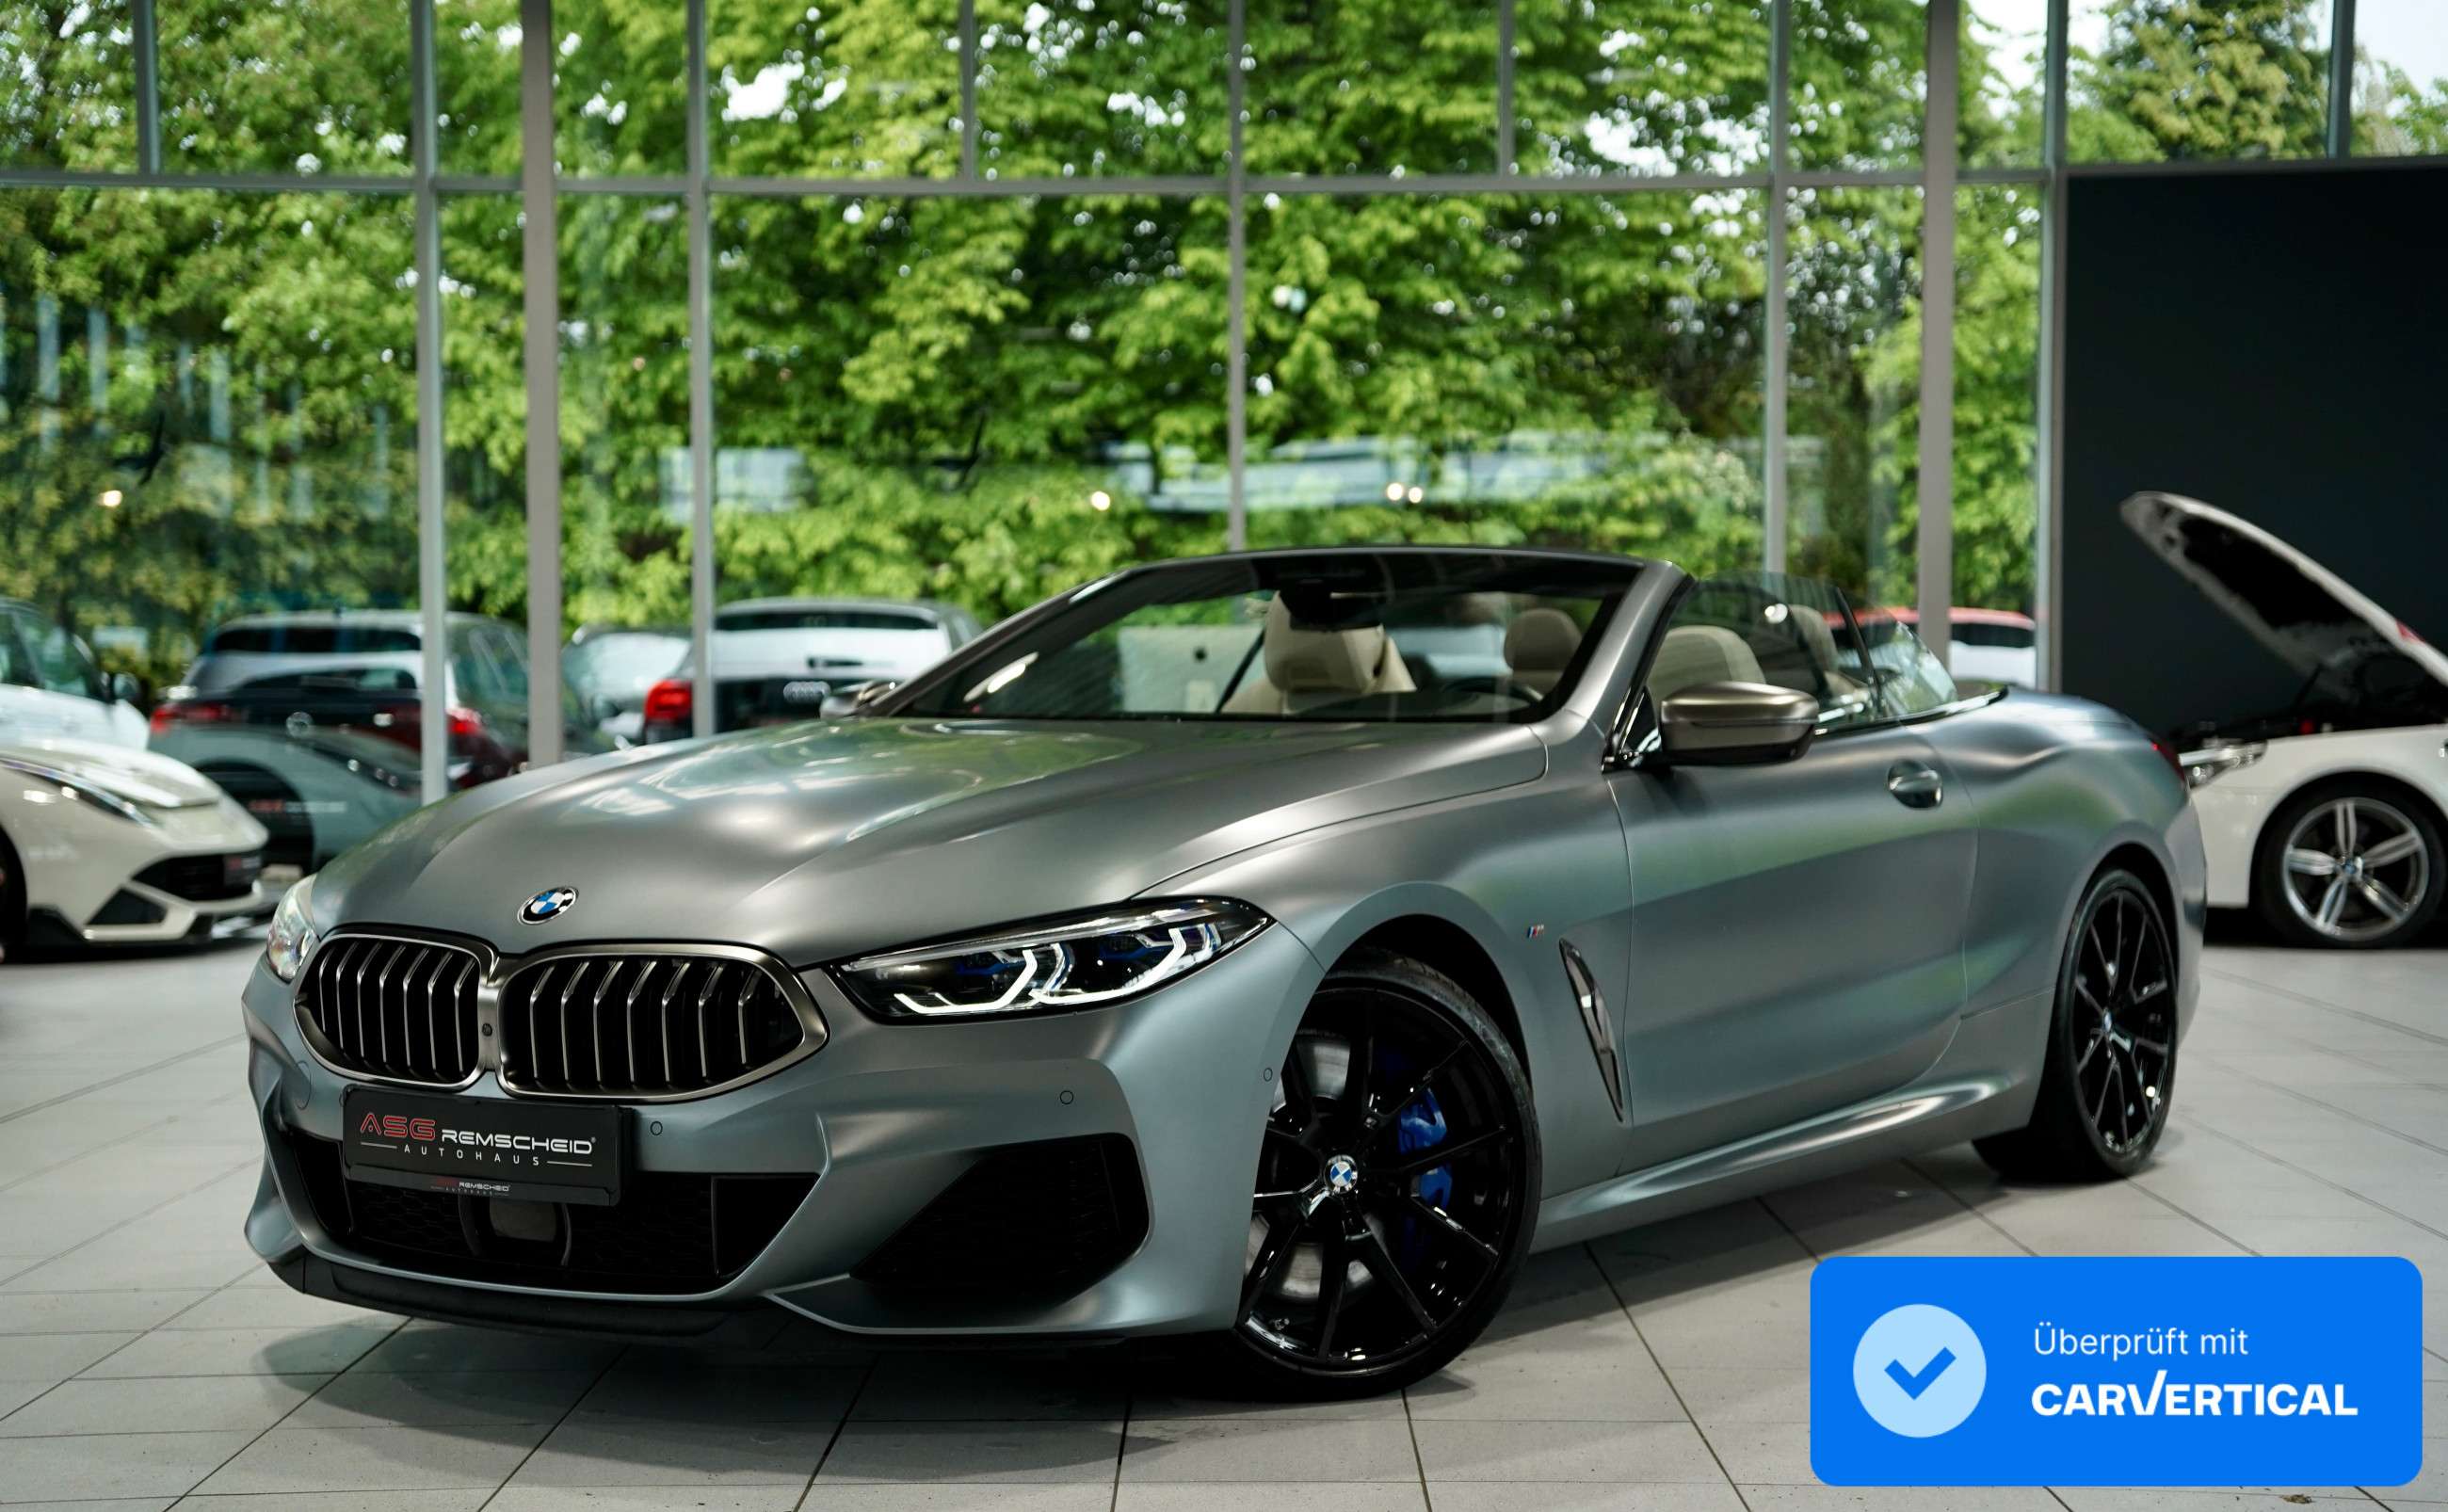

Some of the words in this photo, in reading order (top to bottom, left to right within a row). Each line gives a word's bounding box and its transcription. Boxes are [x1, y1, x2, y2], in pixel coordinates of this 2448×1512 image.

[360, 1112, 436, 1141] ASG
[441, 1129, 593, 1155] REMSCHEID
[403, 1144, 540, 1166] AUTOHAUS
